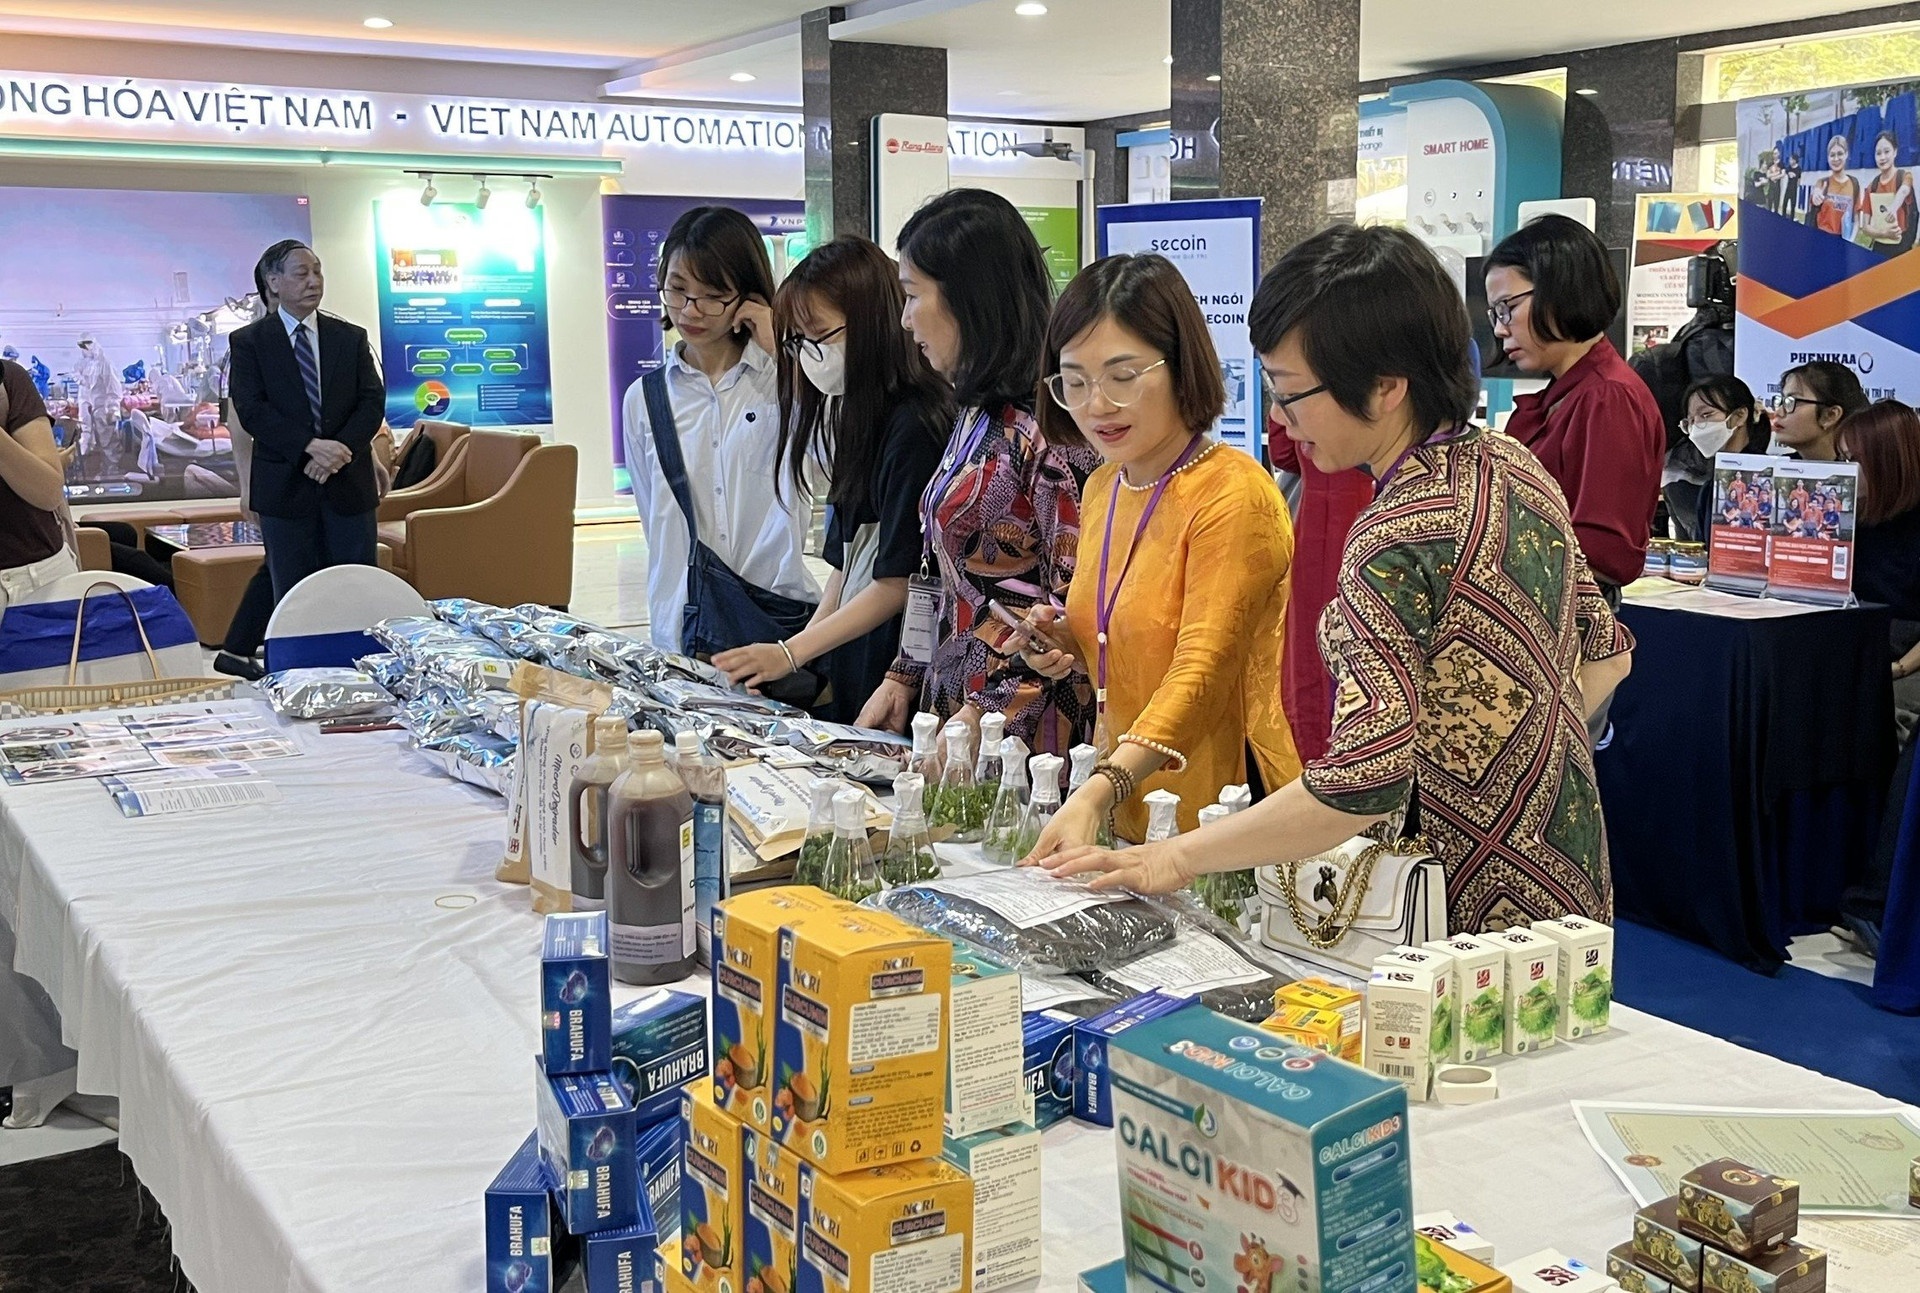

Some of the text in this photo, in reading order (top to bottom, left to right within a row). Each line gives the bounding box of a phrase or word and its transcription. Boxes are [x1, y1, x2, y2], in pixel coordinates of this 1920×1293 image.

[83, 79, 175, 120] HÓA
[182, 86, 273, 131] VIỆT
[285, 96, 372, 130] NAM
[431, 104, 511, 136] VIET
[520, 108, 597, 140] NAM
[1423, 138, 1489, 155] SMART HOME
[1151, 234, 1207, 251] secoin
[1206, 314, 1245, 324] ECOIN
[1212, 292, 1243, 305] NGÓI
[1790, 352, 1857, 365] PHENIKAA
[569, 1009, 584, 1061] BRAHUFA
[648, 1049, 705, 1092] BRAHUFA
[1087, 1072, 1098, 1114] BRAHUFA
[596, 1165, 611, 1219] BRAHUFA
[649, 1160, 681, 1206] RAHUFA
[509, 1205, 523, 1257] BRAHUFA
[617, 1250, 632, 1293] RAHUFA
